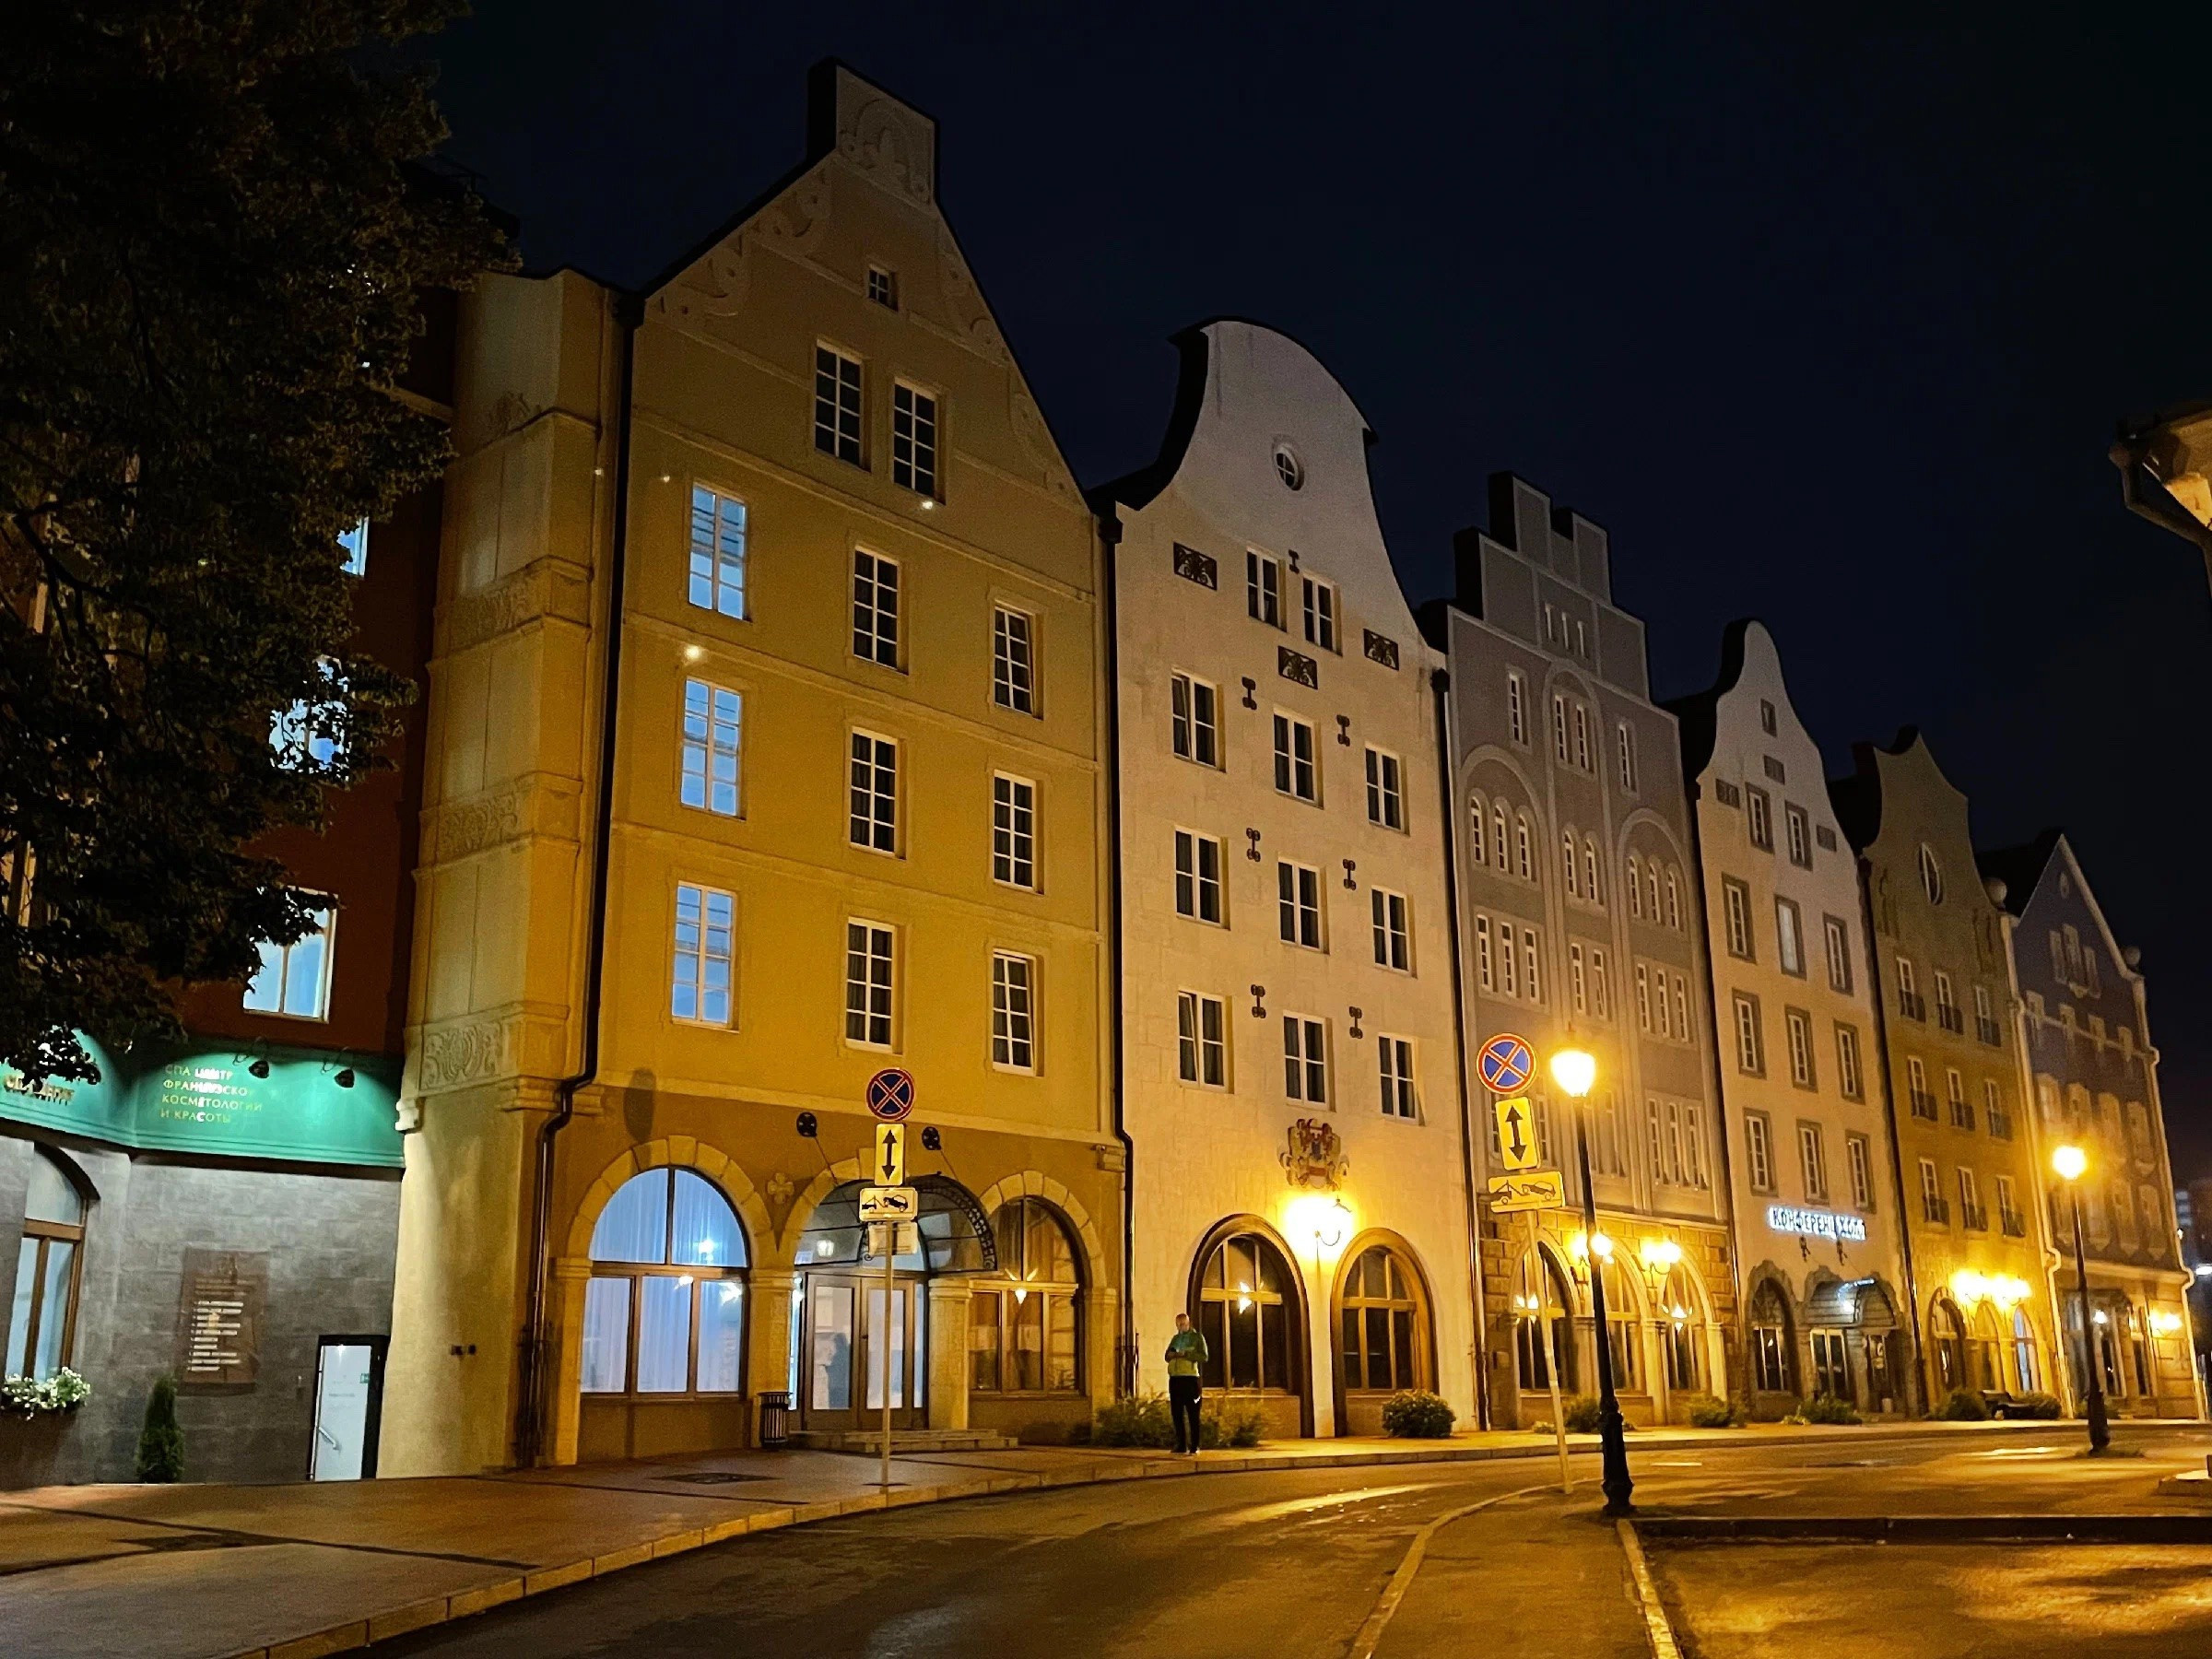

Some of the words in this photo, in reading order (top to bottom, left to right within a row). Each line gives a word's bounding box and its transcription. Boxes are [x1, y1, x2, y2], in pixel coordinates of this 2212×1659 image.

[165, 1064, 191, 1077] СПА
[163, 1079, 254, 1097] ФРАНЦУЗСКО
[174, 1110, 231, 1124] КРАСОТЫ
